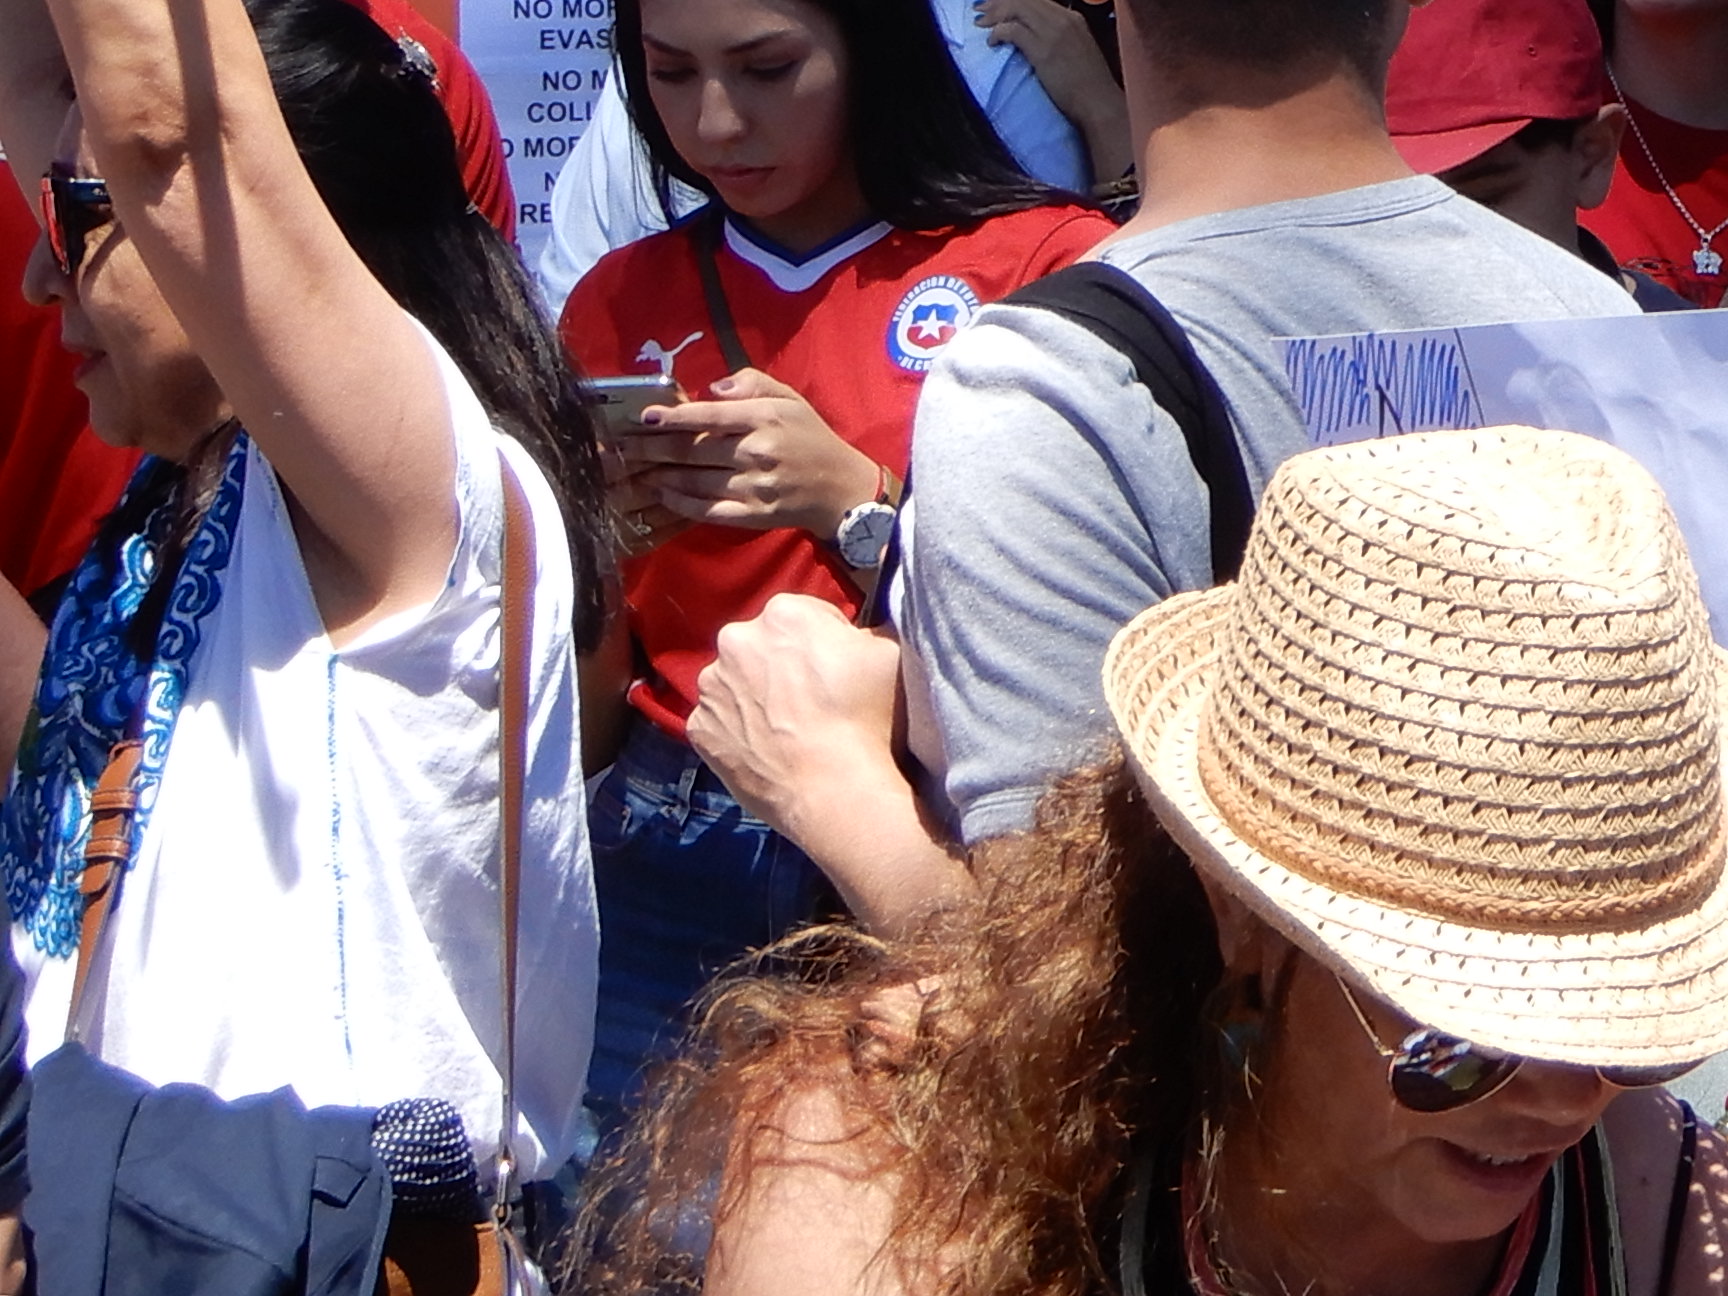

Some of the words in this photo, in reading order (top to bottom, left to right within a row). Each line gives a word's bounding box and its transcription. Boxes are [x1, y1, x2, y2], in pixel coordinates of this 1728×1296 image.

[539, 29, 612, 50] EVAS
[542, 71, 581, 92] NO
[520, 203, 552, 224] RE
